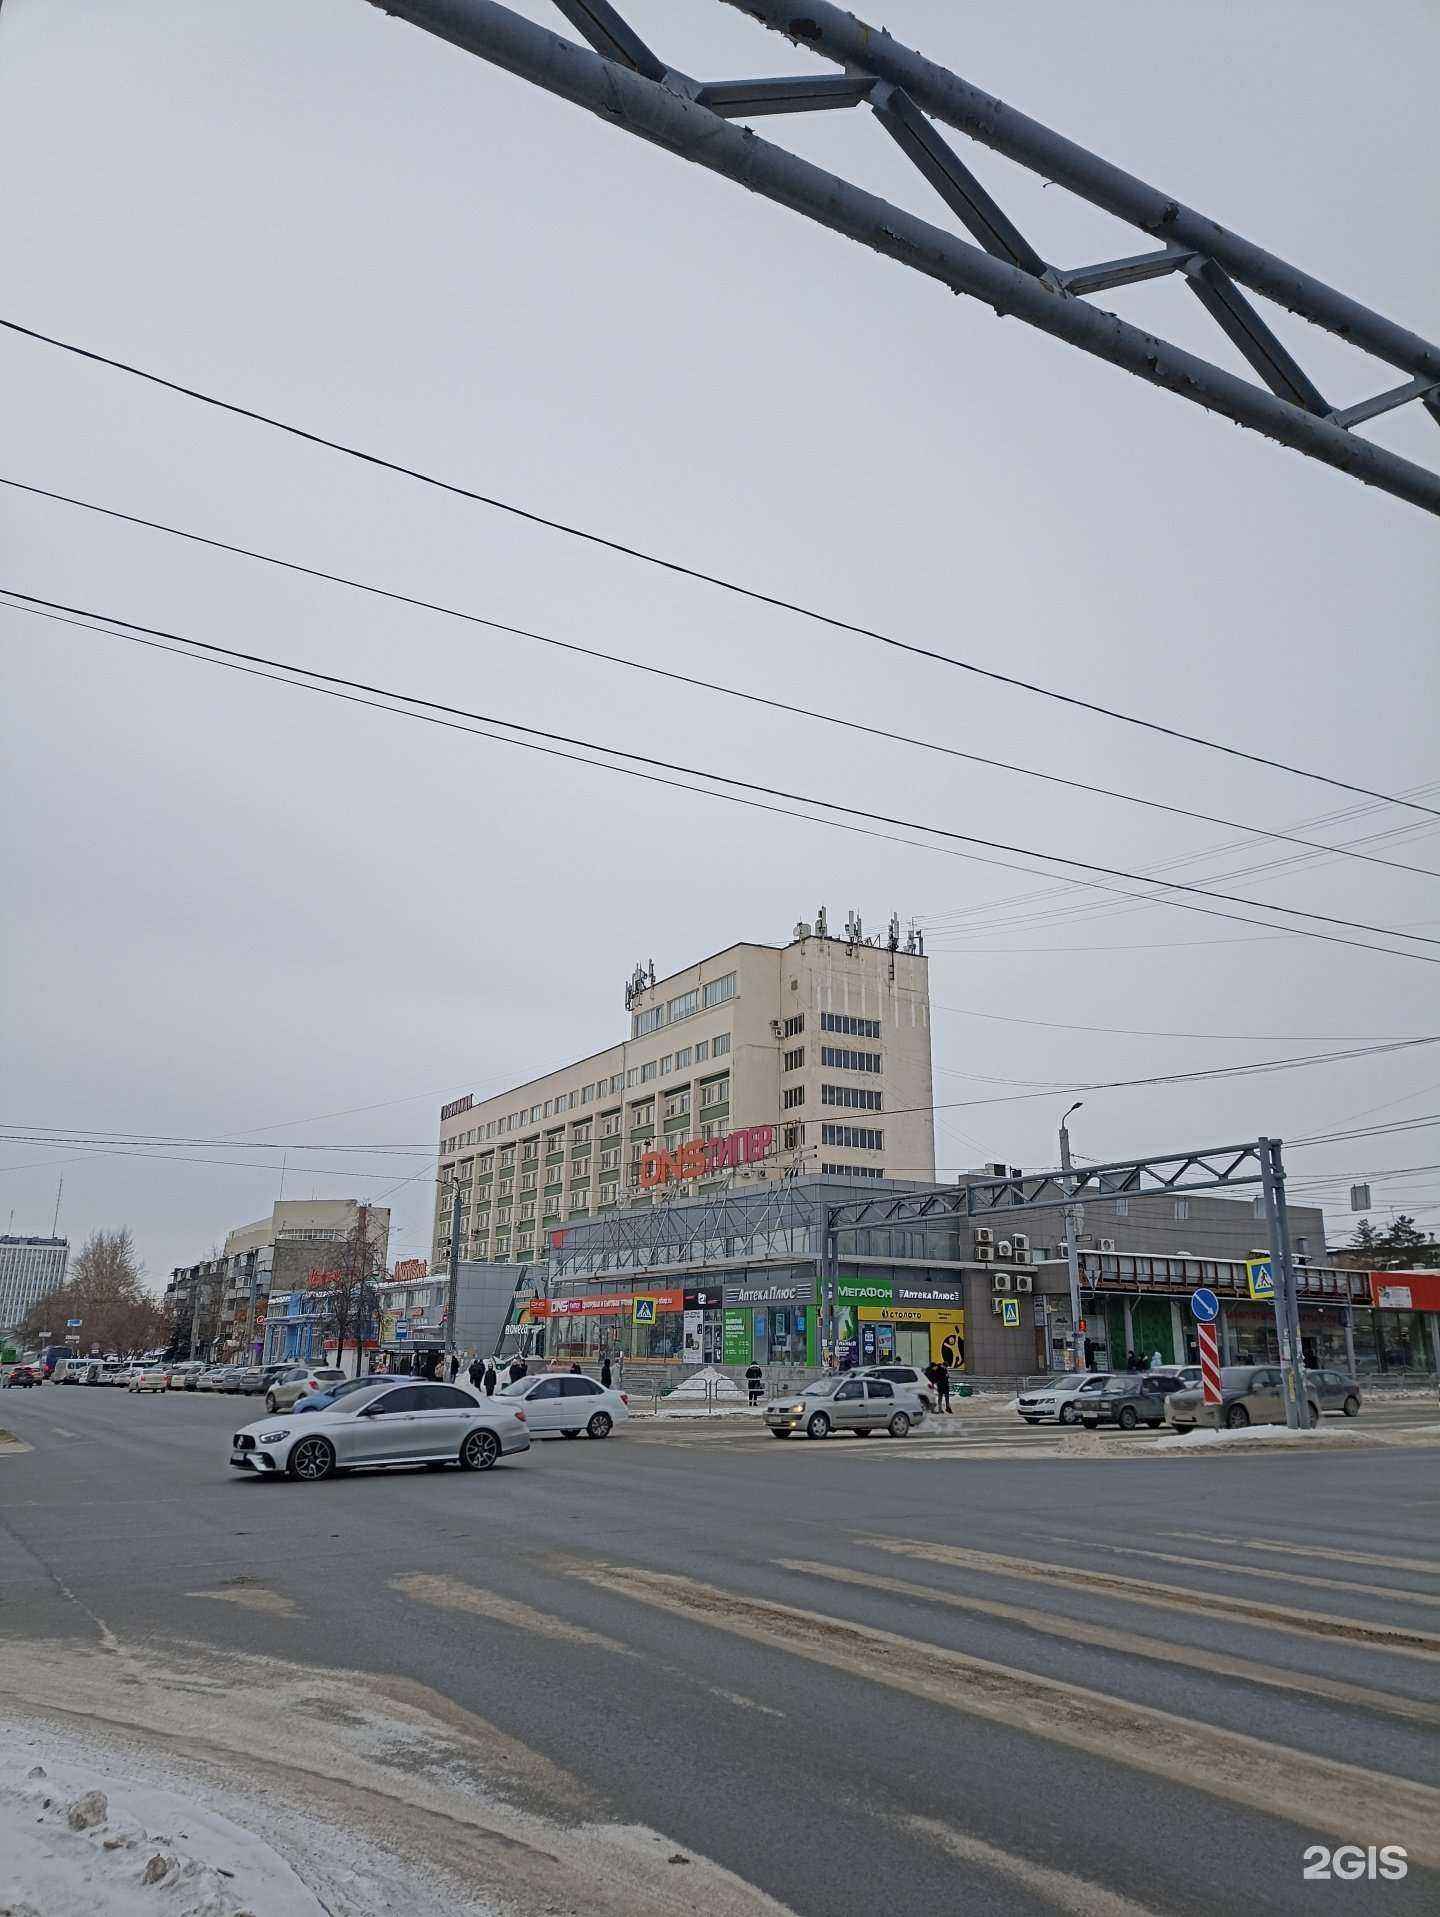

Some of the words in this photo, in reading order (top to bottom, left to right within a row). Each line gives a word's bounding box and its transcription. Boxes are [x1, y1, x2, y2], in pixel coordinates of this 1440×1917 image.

[640, 1138, 706, 1188] DNS
[704, 1125, 773, 1173] ГИПЕР
[550, 1299, 569, 1313] DNS
